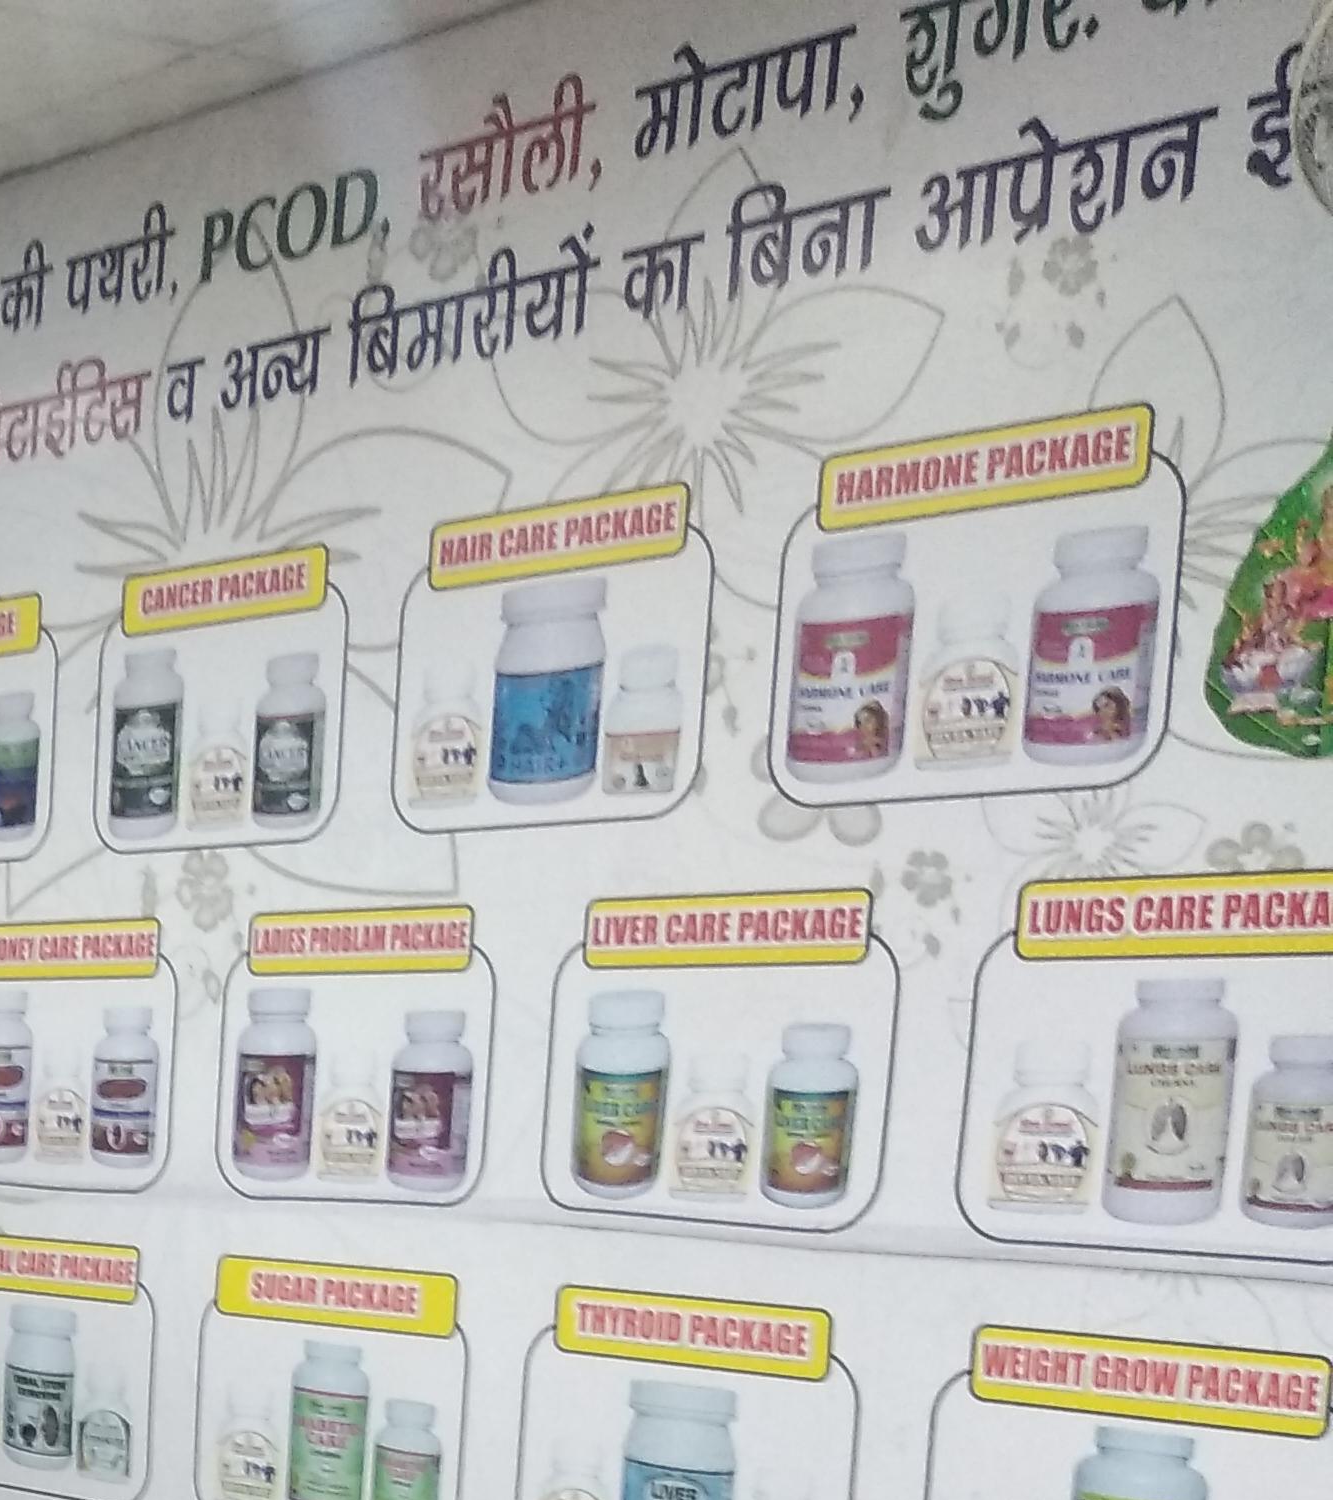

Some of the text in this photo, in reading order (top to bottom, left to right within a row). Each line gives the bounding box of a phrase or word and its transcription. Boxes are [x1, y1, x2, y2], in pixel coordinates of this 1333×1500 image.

[1, 239, 52, 332] की
[67, 202, 177, 313] पथरी,
[200, 169, 390, 283] PCOD,
[420, 74, 601, 221] रसौली,
[635, 24, 863, 159] मोटापा,
[166, 358, 205, 424] व
[219, 326, 331, 411] अन्य
[621, 231, 704, 319] का
[725, 181, 891, 302] बिना
[914, 116, 1219, 252] आप्रेशन
[836, 426, 1132, 505] HARMONE PACKAGE
[440, 501, 677, 567] HAIR CARE PACKAGE
[141, 563, 307, 616] CANCER PACKAGE
[390, 920, 468, 950] PACKAGE
[593, 907, 863, 945] LIVER CARE PACKAGE
[1028, 890, 1333, 935] LUNGS CARE PACKA
[83, 931, 156, 959] PACKAGE
[60, 1254, 134, 1286] PACKAGE
[250, 1271, 418, 1314] SUGAR PACKAGE
[578, 1303, 808, 1356] THYROID PACKAGE
[982, 1344, 1322, 1413] WEIGHT GROW PACKAGE
